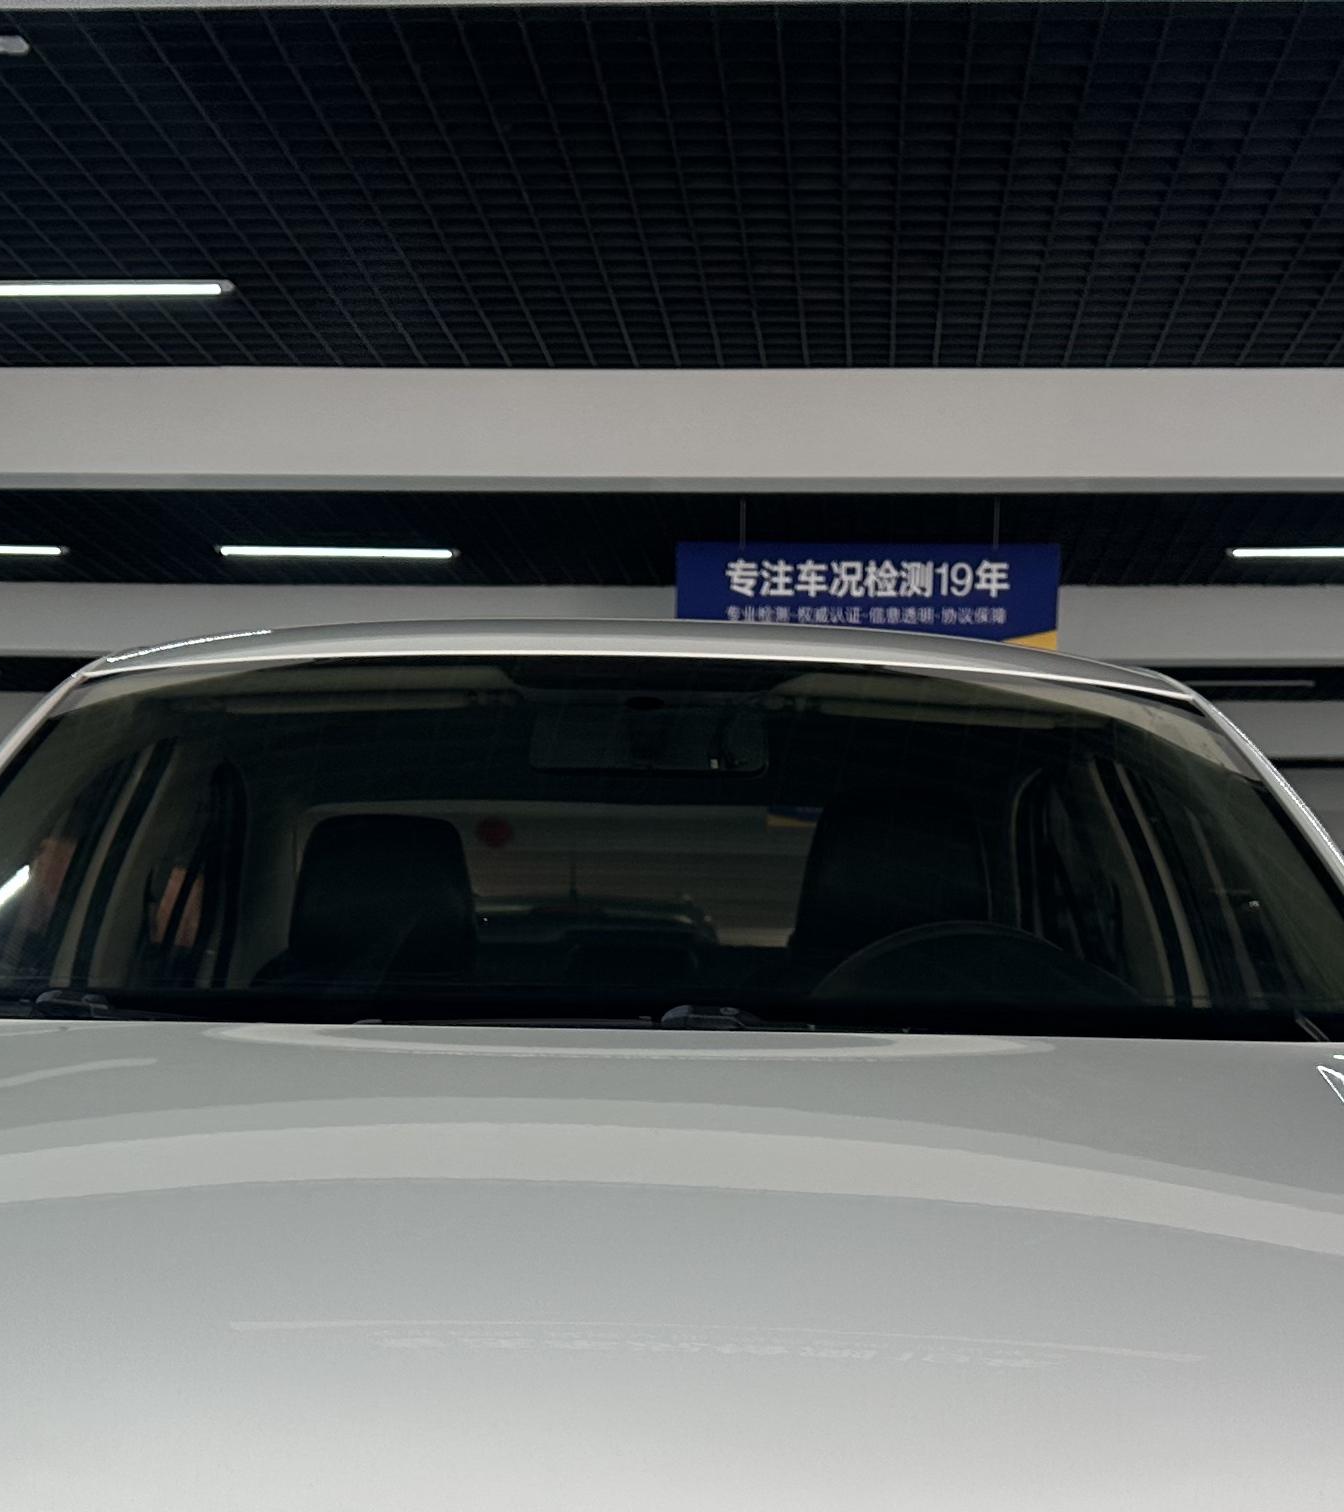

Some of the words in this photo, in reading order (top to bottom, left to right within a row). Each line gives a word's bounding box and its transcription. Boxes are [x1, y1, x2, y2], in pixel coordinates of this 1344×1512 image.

[725, 560, 1011, 598] 专注车况检测19年
